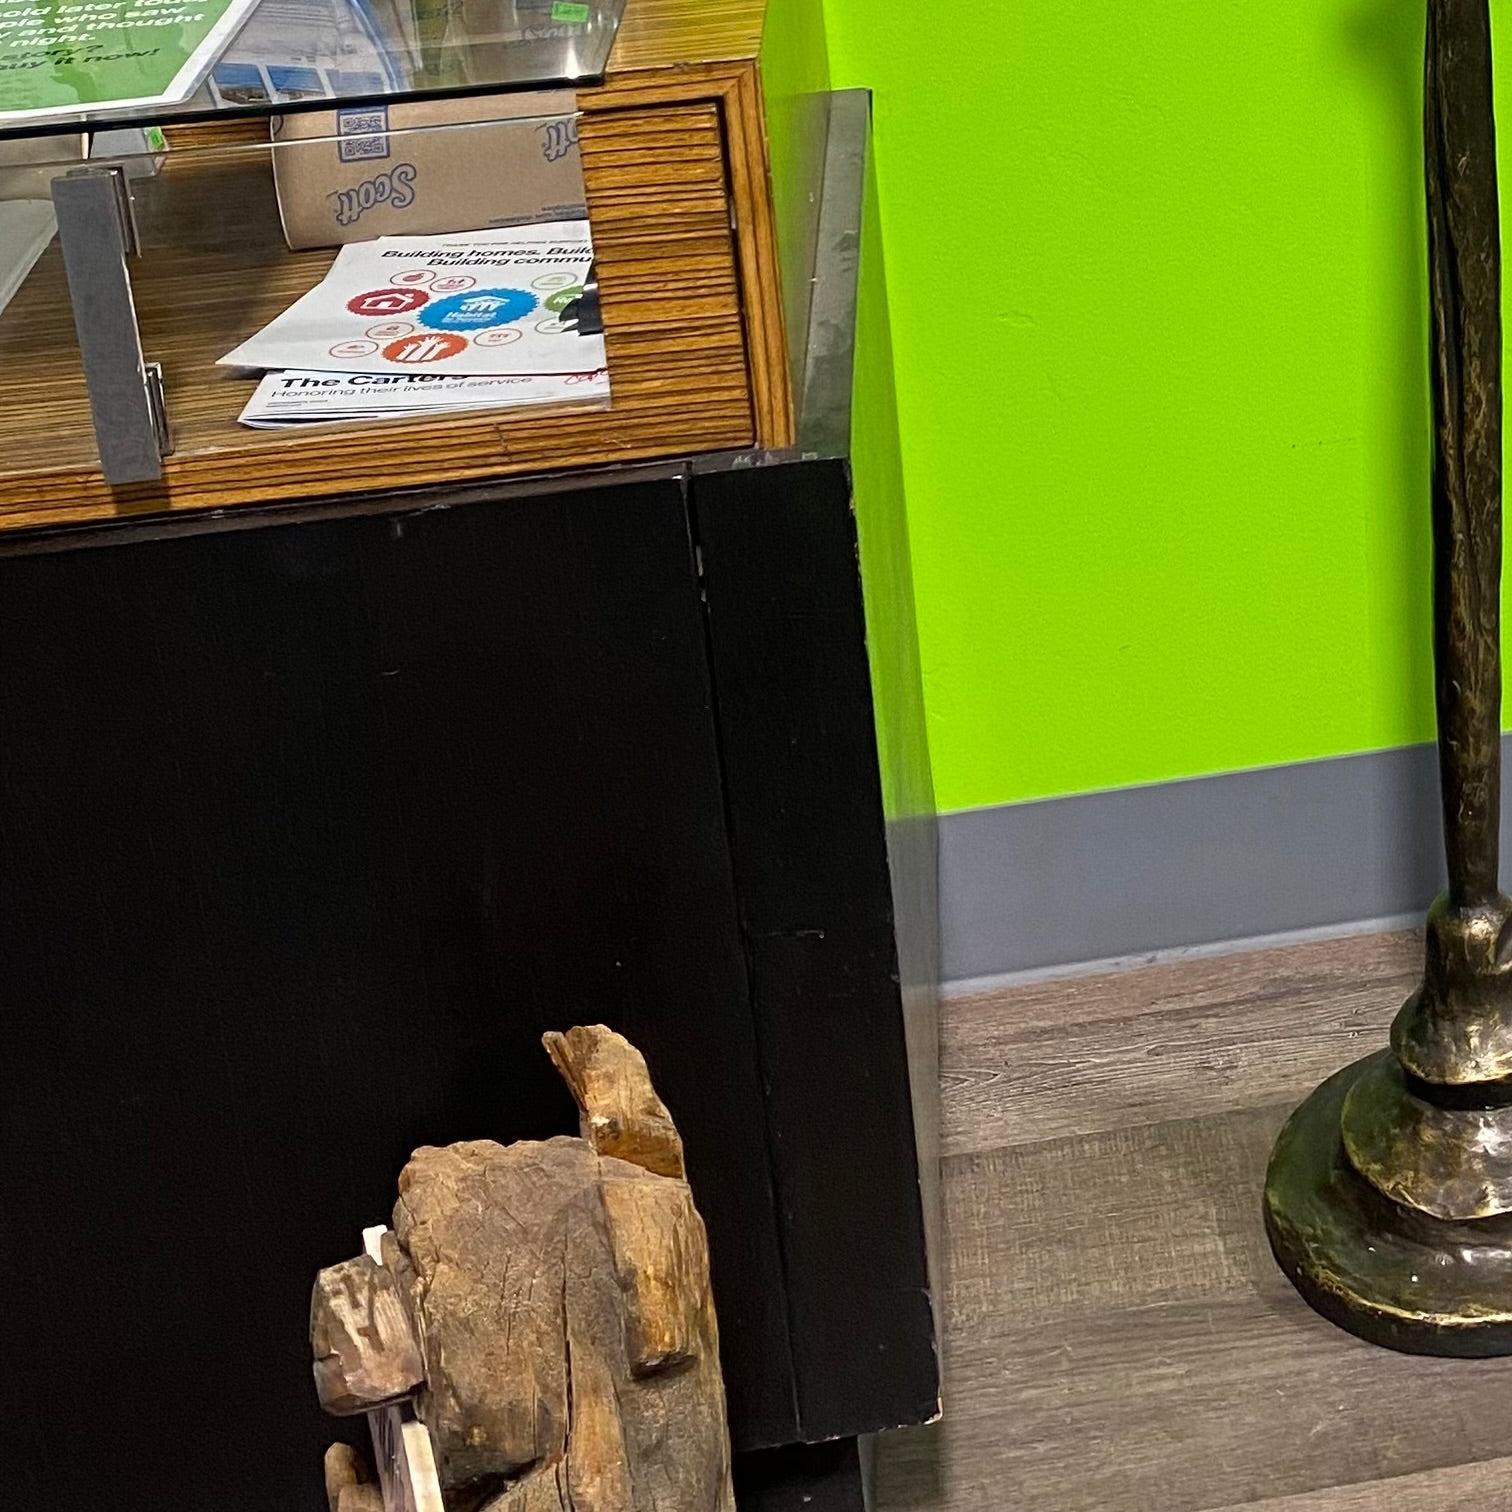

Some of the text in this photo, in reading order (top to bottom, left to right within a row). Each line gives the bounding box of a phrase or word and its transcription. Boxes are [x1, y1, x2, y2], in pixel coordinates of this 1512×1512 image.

[0, 6, 53, 18] old
[56, 2, 127, 14] later
[54, 12, 118, 24] who
[124, 6, 188, 18] saw
[18, 24, 79, 37] and
[86, 13, 206, 31] thought
[9, 33, 97, 47] night.
[82, 48, 161, 63] now!
[333, 162, 417, 227] Scott
[381, 249, 465, 259] Building
[468, 248, 541, 257] homes.
[427, 256, 513, 267] Building
[271, 377, 533, 398] Honoring their lives of service
[281, 377, 341, 388] The
